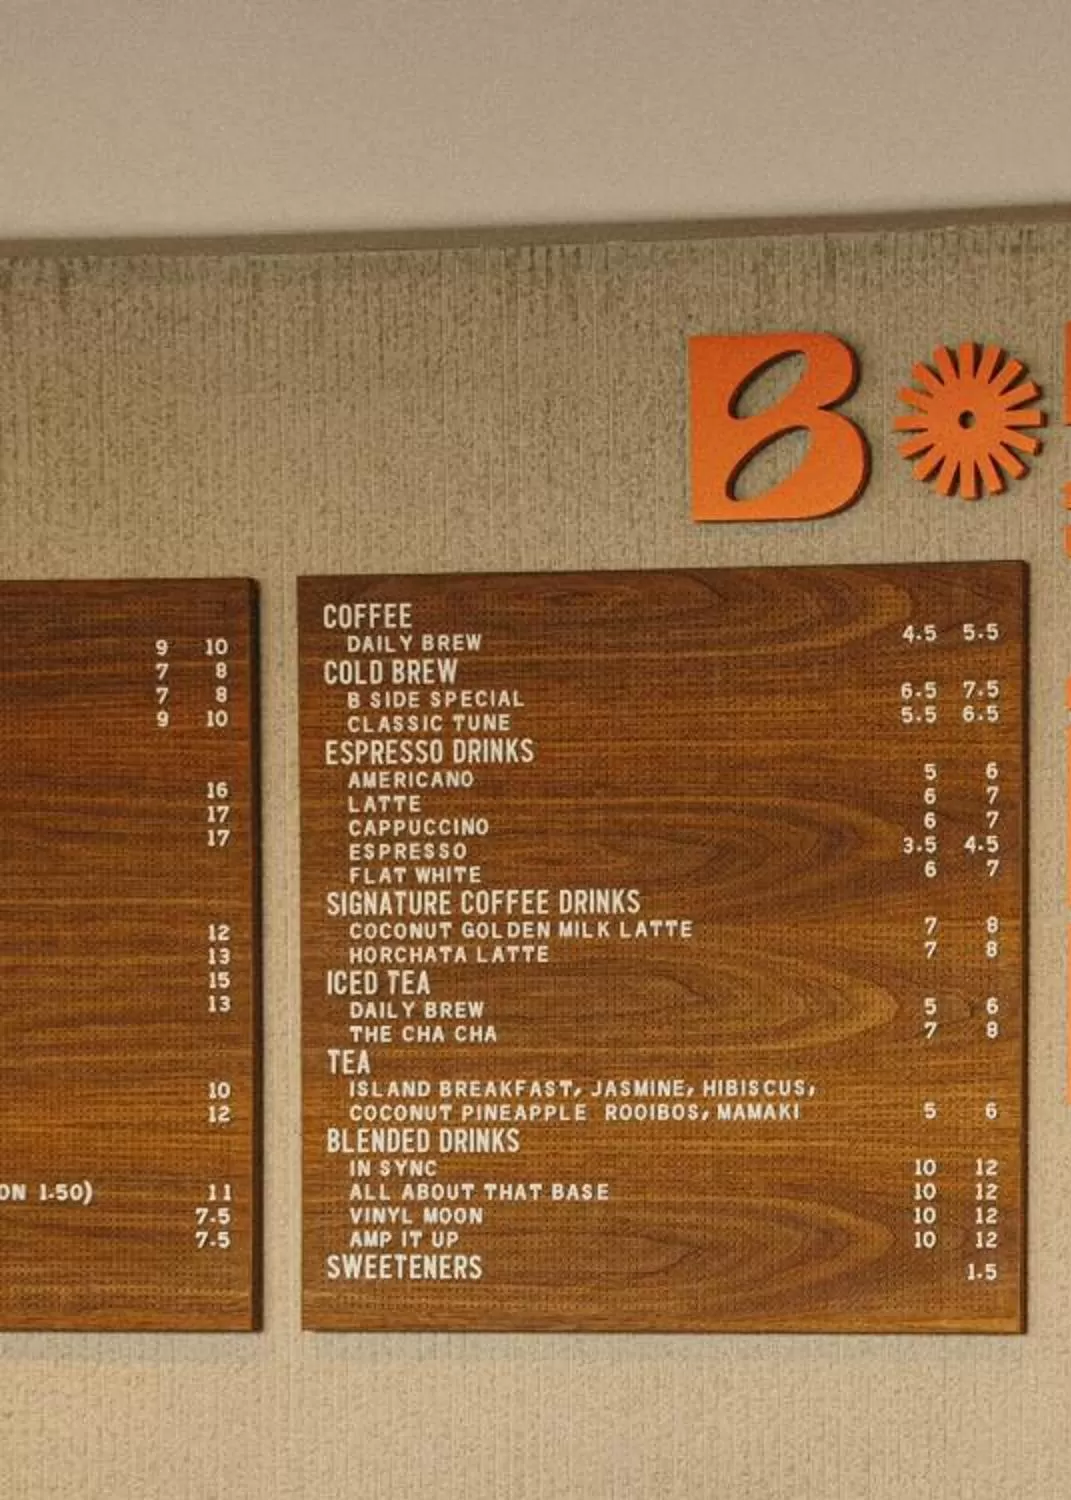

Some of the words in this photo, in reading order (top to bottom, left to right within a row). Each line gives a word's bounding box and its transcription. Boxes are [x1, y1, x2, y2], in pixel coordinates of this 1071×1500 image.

[688, 332, 873, 523] B
[323, 602, 412, 629] COFFEE
[902, 624, 937, 643] 4.5
[963, 623, 999, 641] 5.5
[155, 639, 169, 657] 9
[206, 638, 229, 656] 10
[347, 634, 413, 653] DAILY
[421, 633, 482, 651] BREW
[155, 662, 169, 680] 7
[215, 661, 227, 679] 8
[323, 659, 383, 685] COLD
[392, 657, 458, 685] BREW
[155, 686, 169, 705] 7
[215, 686, 227, 703] 8
[347, 691, 361, 709] B
[370, 690, 420, 709] SIDE
[430, 689, 524, 708] SPECIAL
[901, 681, 937, 700] 6.5
[963, 679, 999, 699] 7.5
[157, 710, 169, 728] 9
[207, 709, 228, 727] 10
[347, 714, 443, 733] CLASSIC
[452, 713, 510, 732] TUNE
[901, 705, 937, 724] 5.5
[962, 704, 999, 723] 6.5
[325, 738, 444, 765] ESPRESSO
[453, 737, 534, 764] DRINKS
[348, 770, 474, 789] AMERICANO
[924, 763, 937, 781] 5
[985, 761, 999, 780] 6
[207, 781, 228, 799] 16
[923, 787, 937, 805] 6
[986, 785, 999, 805] 7
[348, 794, 421, 813] LATTE
[207, 805, 230, 823] 17
[923, 811, 937, 830] 6
[986, 810, 999, 829] 7
[348, 817, 489, 837] CAPPUCCINO
[207, 829, 230, 847] 17
[903, 835, 937, 854] 3.5
[963, 835, 999, 854] 4.5
[349, 842, 467, 861] ESPRESSO
[349, 866, 407, 885] FLAT
[415, 865, 481, 884] WHITE
[924, 860, 937, 878] 6
[986, 859, 1000, 877] 7
[326, 890, 452, 917] SIGNATURE
[460, 889, 549, 915] COFFEE
[559, 888, 641, 915] DRINKS
[208, 923, 230, 942] 12
[349, 921, 453, 940] COCONUT
[461, 921, 551, 940] GOLDEN
[558, 920, 610, 939] MILK
[619, 919, 693, 938] LATTE
[924, 916, 937, 935] 7
[986, 915, 999, 934] 8
[208, 947, 230, 965] 13
[349, 945, 467, 964] HORCHATA
[476, 944, 549, 963] LATTE
[924, 940, 937, 959] 7
[985, 940, 998, 958] 8
[209, 971, 231, 989] 15
[327, 969, 378, 996] ICED
[387, 969, 431, 995] TEA
[208, 995, 231, 1013] 13
[349, 1001, 415, 1019] DAILY
[424, 1001, 485, 1019] BREW
[924, 997, 937, 1016] 5
[986, 996, 999, 1015] 6
[349, 1025, 392, 1043] THE
[401, 1025, 445, 1043] CHA
[454, 1025, 497, 1043] CHA
[923, 1021, 938, 1039] 7
[986, 1020, 999, 1039] 8
[327, 1048, 371, 1075] TEA
[209, 1081, 231, 1099] 10
[349, 1079, 431, 1098] ISLAND
[439, 1079, 582, 1098] BREAKFAST,
[591, 1079, 695, 1098] JASMINE,
[702, 1079, 816, 1097] HIBISCUS,
[209, 1104, 230, 1123] 12
[349, 1103, 453, 1122] COCONUT
[461, 1103, 586, 1122] PINEAPPLE
[605, 1103, 710, 1121] ROOIBOS,
[717, 1102, 800, 1121] MAMAKI
[923, 1101, 937, 1120] 5
[985, 1101, 998, 1120] 6
[327, 1127, 430, 1154] BLENDED
[439, 1127, 520, 1153] DRINKS
[349, 1159, 371, 1177] IN
[379, 1159, 437, 1177] SYNC
[915, 1158, 937, 1177] 10
[975, 1158, 999, 1177] 12
[39, 1180, 93, 1205] 1.50)
[208, 1183, 231, 1202] 11
[349, 1183, 391, 1201] ALL
[401, 1182, 475, 1201] ABOUT
[483, 1182, 543, 1201] THAT
[551, 1183, 609, 1201] BASE
[914, 1182, 937, 1201] 10
[975, 1182, 999, 1201] 12
[195, 1207, 231, 1226] 7.5
[349, 1206, 413, 1225] VINYL
[423, 1206, 483, 1225] MOON
[914, 1206, 937, 1225] 10
[975, 1206, 998, 1225] 12
[195, 1231, 231, 1249] 7.5
[349, 1229, 393, 1249] AMP
[401, 1230, 423, 1248] IT
[431, 1230, 459, 1249] UP
[914, 1230, 937, 1249] 10
[975, 1231, 998, 1249] 12
[326, 1253, 483, 1280] SWEETENERS
[967, 1263, 997, 1281] 1.5
